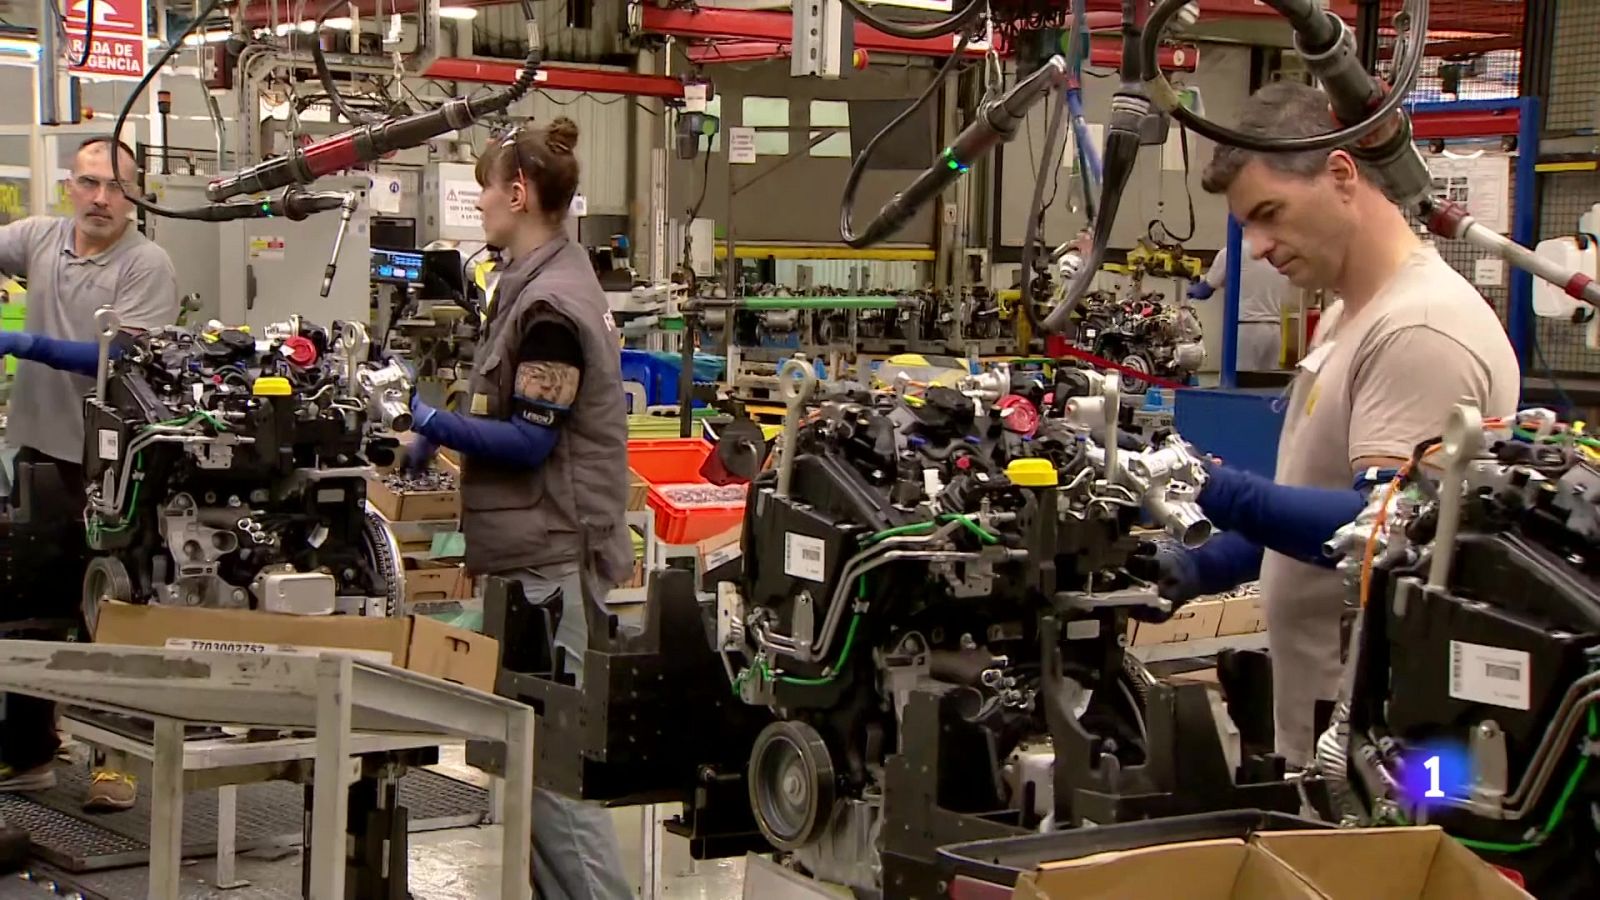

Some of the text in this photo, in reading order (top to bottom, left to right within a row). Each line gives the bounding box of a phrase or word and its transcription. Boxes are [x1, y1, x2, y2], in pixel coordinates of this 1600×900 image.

[72, 40, 133, 57] RDA DE
[87, 54, 141, 72] GENCIA
